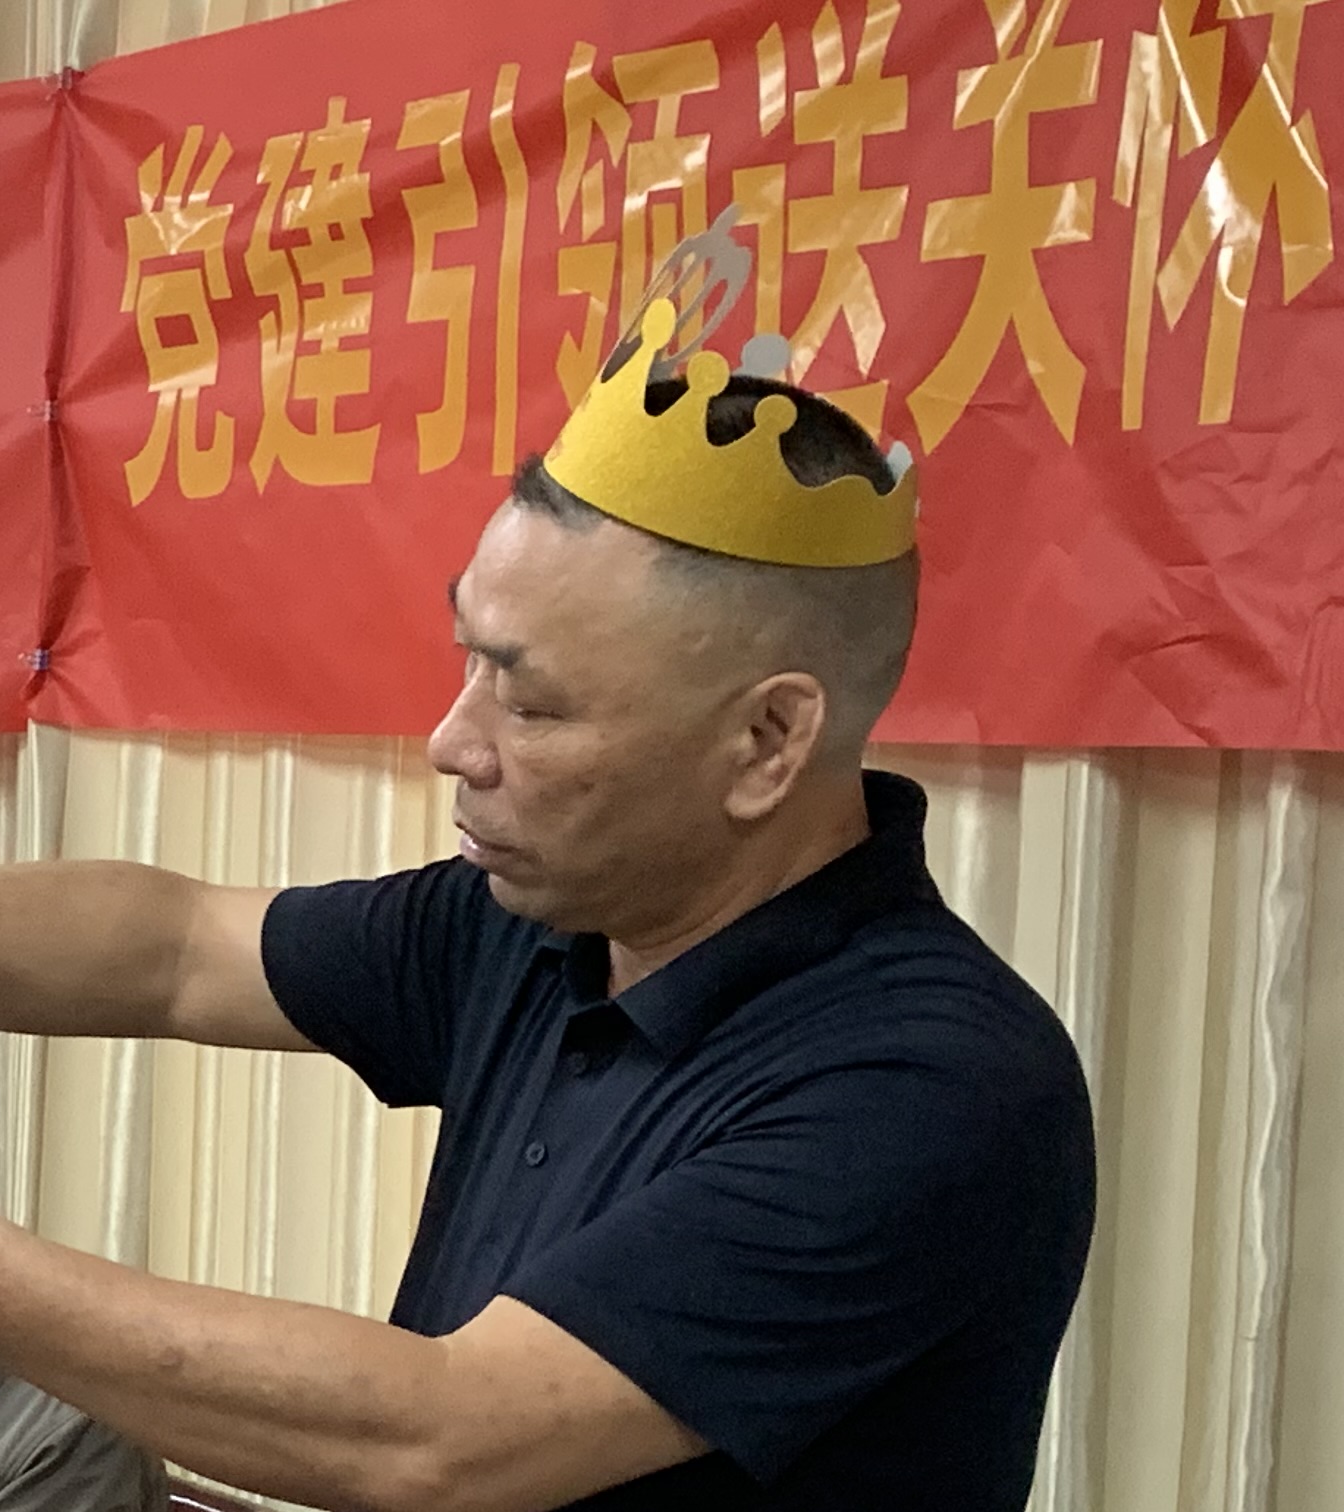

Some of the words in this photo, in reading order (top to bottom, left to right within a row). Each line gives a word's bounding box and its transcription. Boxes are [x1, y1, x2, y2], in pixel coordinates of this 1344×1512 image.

[120, 0, 1336, 507] 党建引领送关怀
